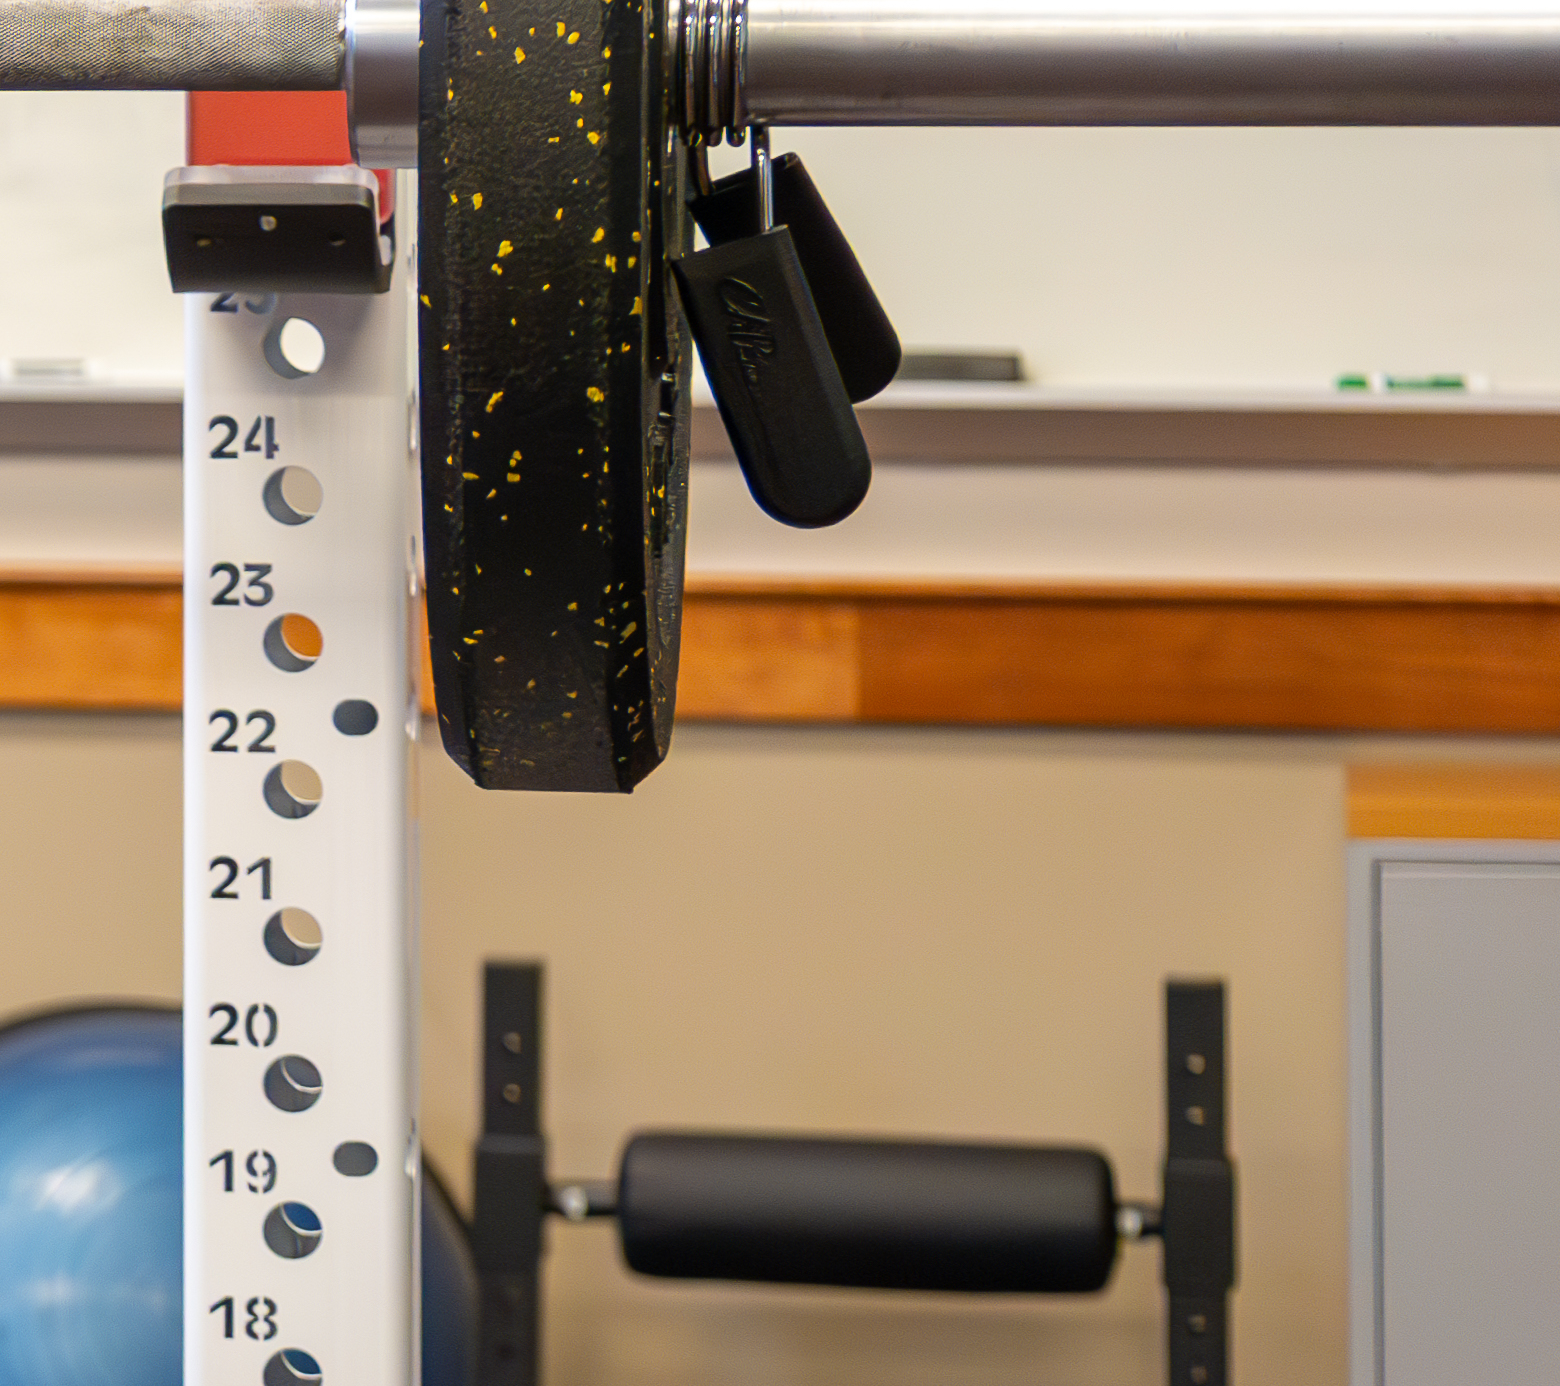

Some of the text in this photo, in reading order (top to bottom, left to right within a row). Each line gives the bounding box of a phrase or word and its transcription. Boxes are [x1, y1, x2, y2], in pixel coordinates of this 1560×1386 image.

[207, 414, 280, 461] 24
[209, 560, 276, 608] 23
[207, 707, 278, 755] 22
[208, 854, 273, 902] 21
[207, 1001, 280, 1049] 20
[208, 1148, 279, 1195] 19
[208, 1294, 280, 1342] 18
